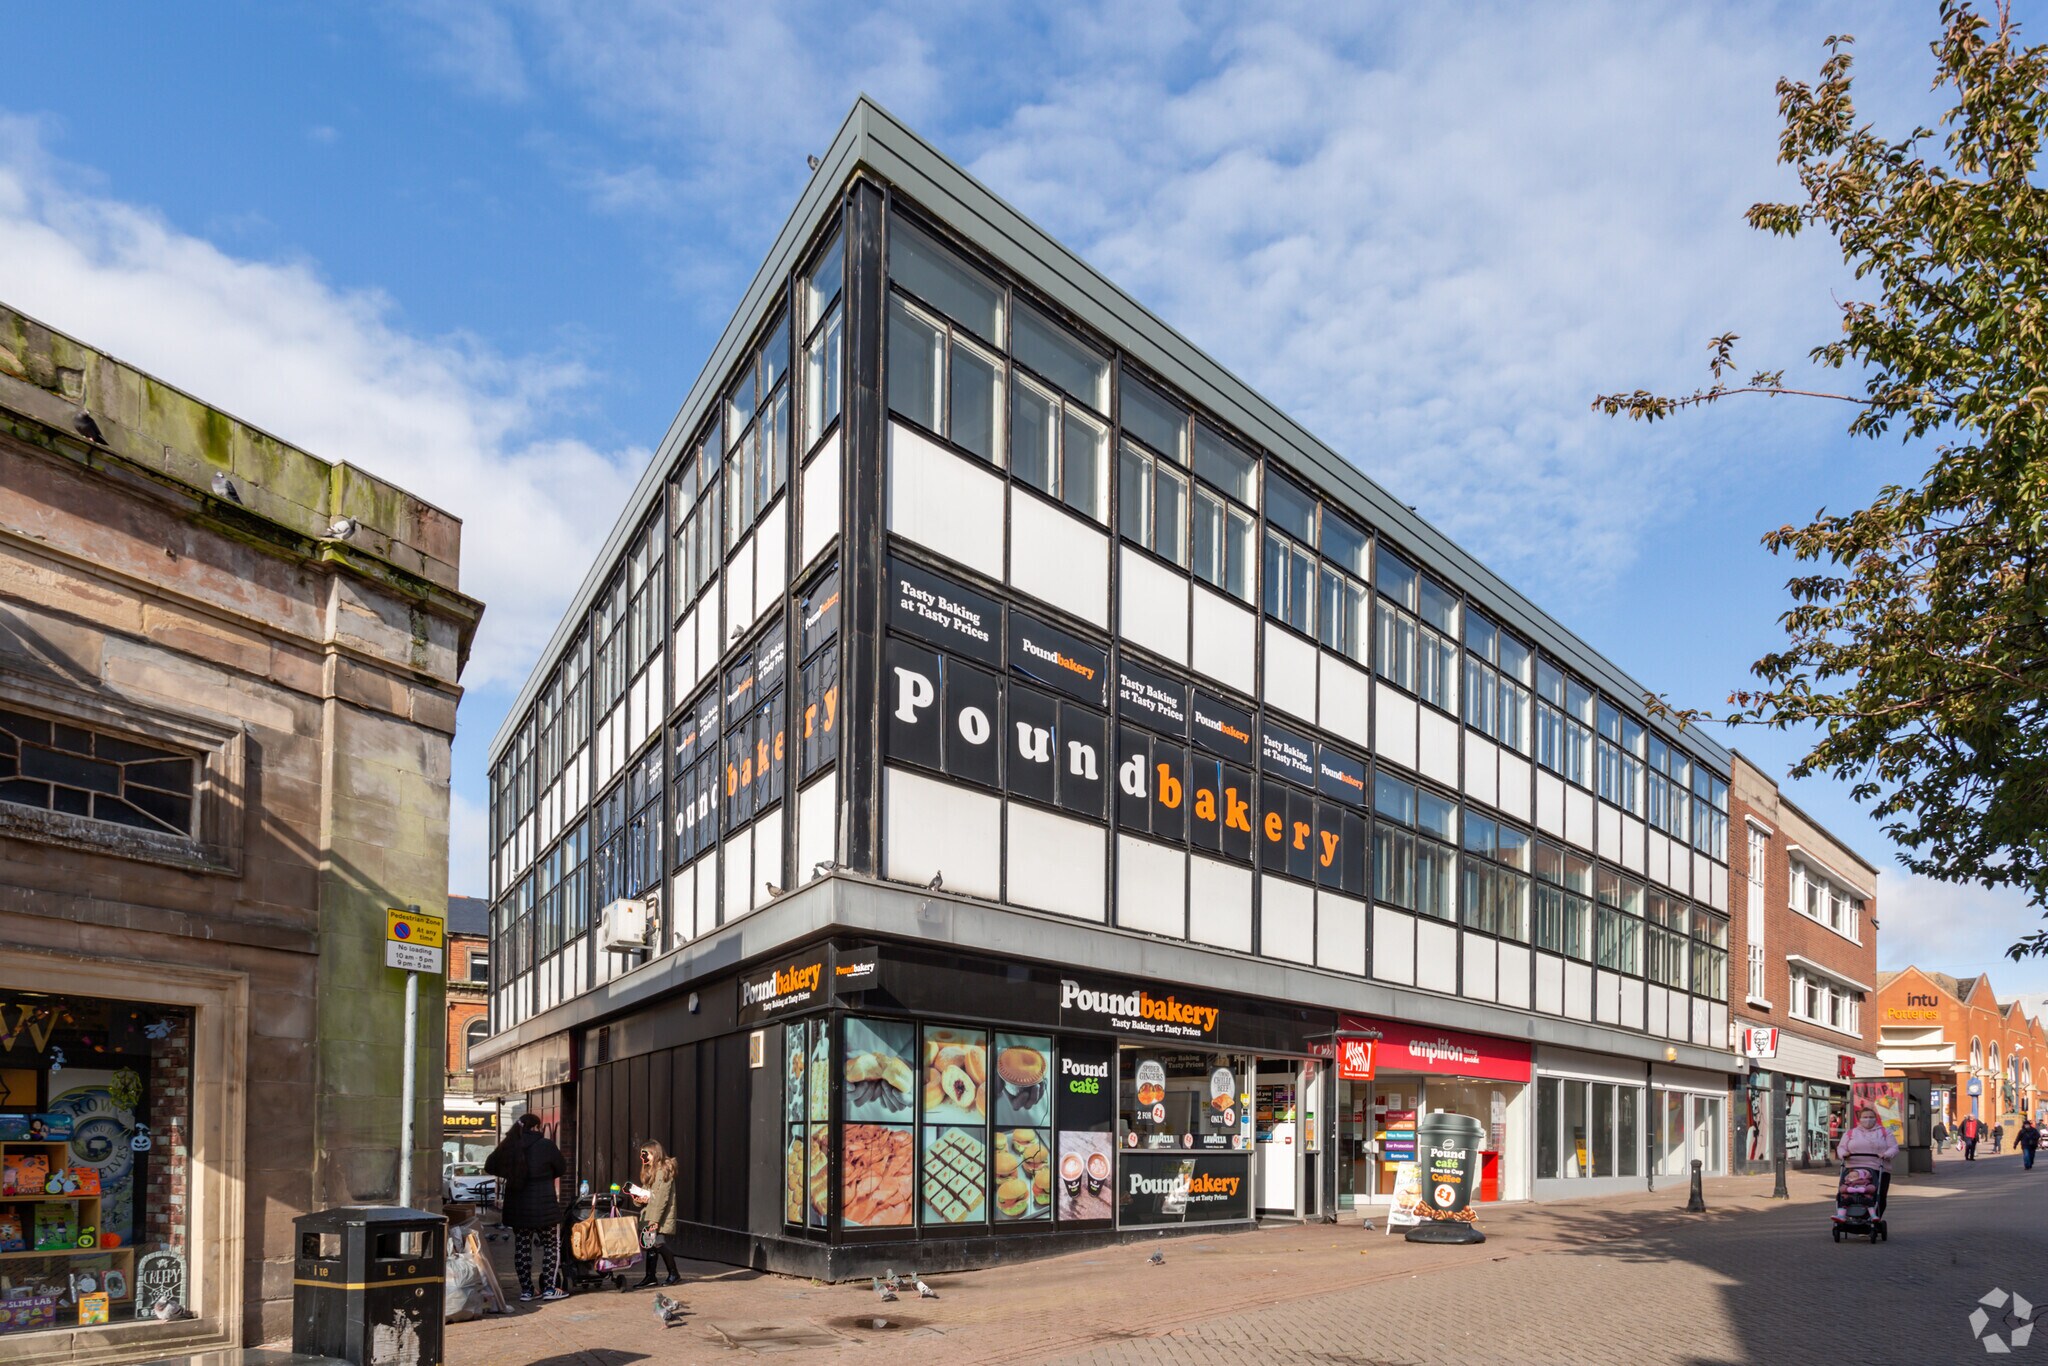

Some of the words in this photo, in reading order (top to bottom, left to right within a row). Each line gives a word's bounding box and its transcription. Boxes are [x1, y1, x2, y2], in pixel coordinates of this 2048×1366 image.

[901, 580, 935, 605] Tasty
[938, 595, 981, 626] Baking
[901, 598, 914, 611] at
[917, 602, 951, 628] Tasty
[954, 617, 989, 642] Prices
[1022, 638, 1095, 680] Poundbakery
[1120, 674, 1145, 696] Tasty
[1147, 687, 1178, 709] Baking
[1120, 688, 1130, 700] at
[1131, 692, 1157, 714] Tasty
[1158, 704, 1184, 722] Prices
[1195, 711, 1250, 744] Poundbakery
[1263, 734, 1283, 751] Tasty
[1283, 743, 1308, 763] Baking
[1263, 747, 1271, 757] at
[1272, 750, 1292, 767] Tasty
[1292, 758, 1312, 774] Prices
[1321, 763, 1364, 791] Poundbakery
[390, 911, 425, 923] Pedestrian
[425, 918, 441, 926] Zone
[409, 946, 433, 955] loading
[835, 963, 875, 976] Poundbakery
[743, 963, 822, 1006] Poundbakery
[1060, 979, 1219, 1032] Poundbakery
[1907, 992, 1938, 1007] intu
[1888, 1007, 1938, 1019] Potteries
[1111, 1018, 1132, 1029] Tasty
[1132, 1020, 1156, 1033] Baking
[1156, 1024, 1164, 1032] at
[1164, 1024, 1182, 1036] Tasty
[1182, 1027, 1201, 1036] Prices
[1408, 1038, 1463, 1064] amplifon
[1061, 1058, 1108, 1077] Pound
[1069, 1077, 1099, 1095] café
[70, 1098, 114, 1117] ROW
[1137, 1111, 1142, 1119] 2
[1142, 1111, 1152, 1119] FOR
[1154, 1107, 1163, 1118] £1
[1225, 1112, 1233, 1121] £1
[1211, 1115, 1223, 1124] ONLY
[1430, 1148, 1466, 1159] Pound
[1435, 1158, 1458, 1168] café
[1129, 1173, 1240, 1196] Poundbakery
[1431, 1173, 1461, 1183] Coffee
[1437, 1188, 1452, 1202] £1
[143, 1271, 181, 1284] CREEPY
[8, 1299, 33, 1309] SLIME
[34, 1298, 52, 1306] LAB
